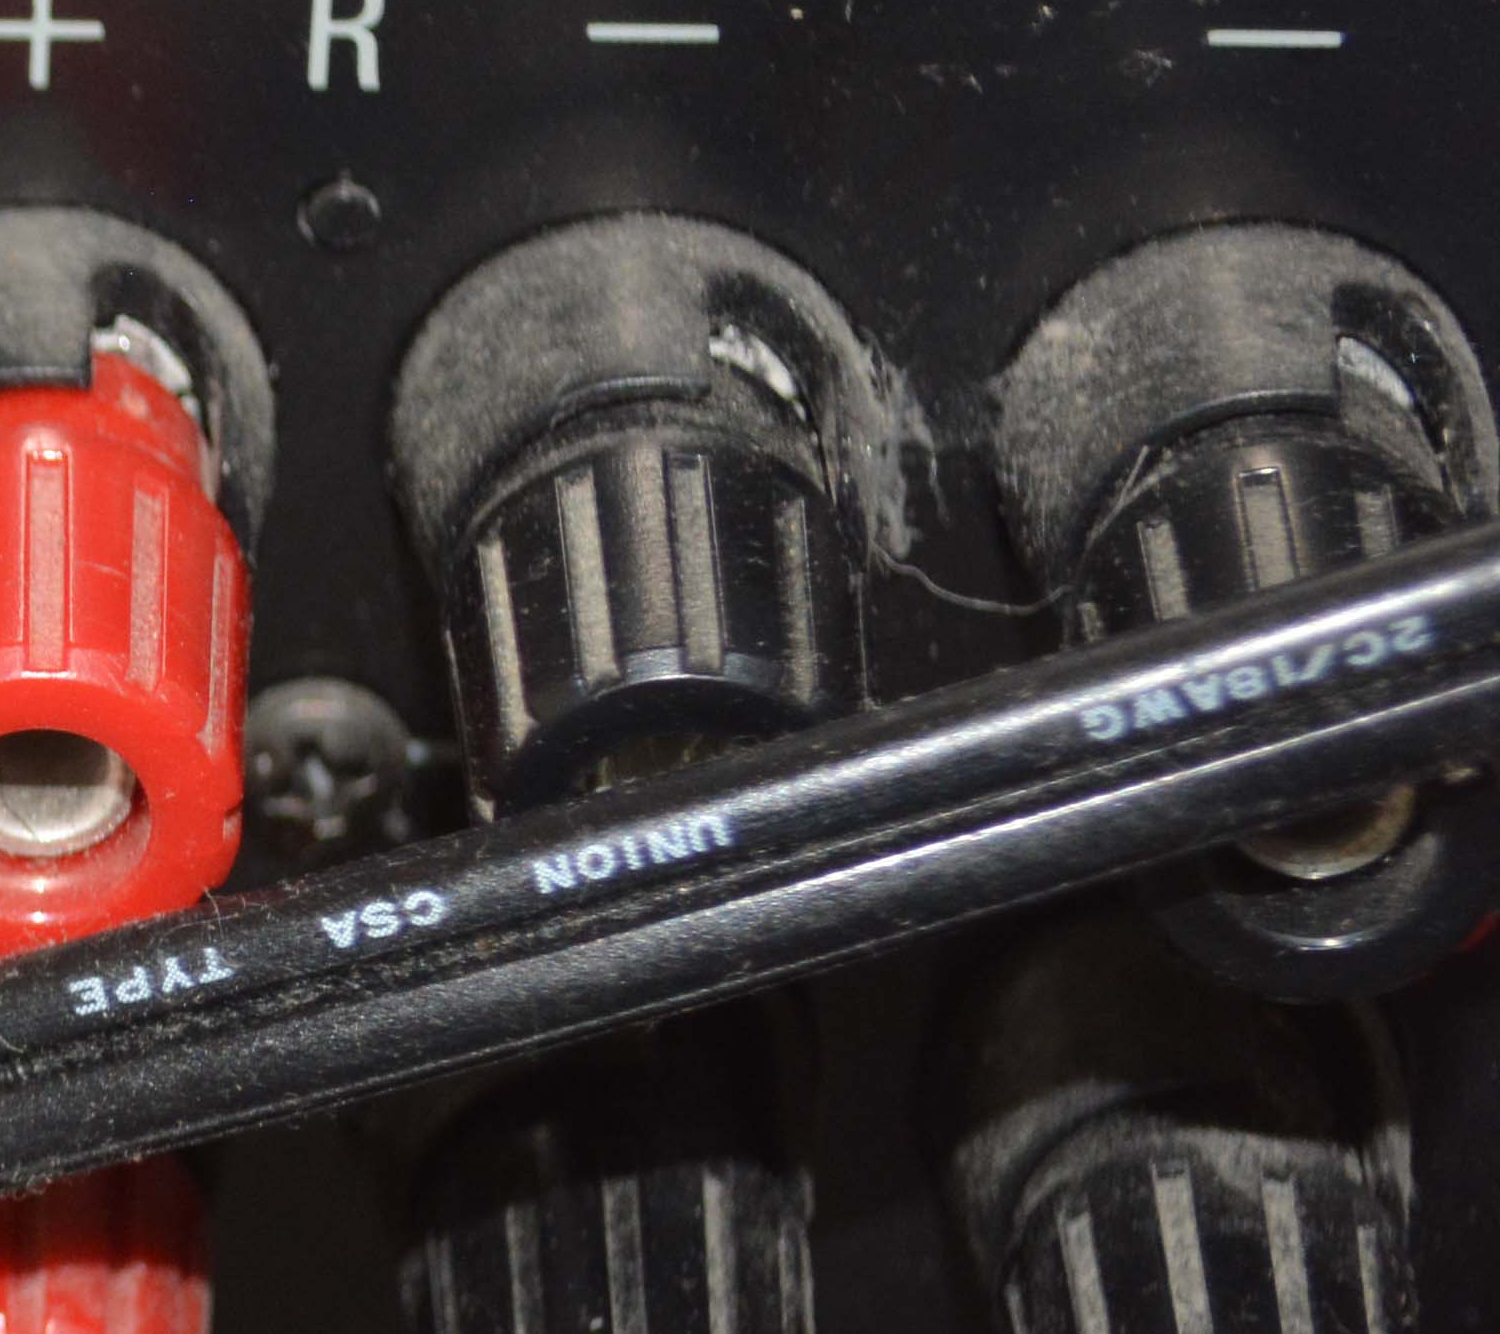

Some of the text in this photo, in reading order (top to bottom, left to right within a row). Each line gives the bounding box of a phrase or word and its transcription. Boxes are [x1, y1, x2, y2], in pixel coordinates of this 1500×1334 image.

[533, 816, 734, 894] UNION
[321, 891, 449, 949] CSA
[69, 947, 235, 1015] TYPE
